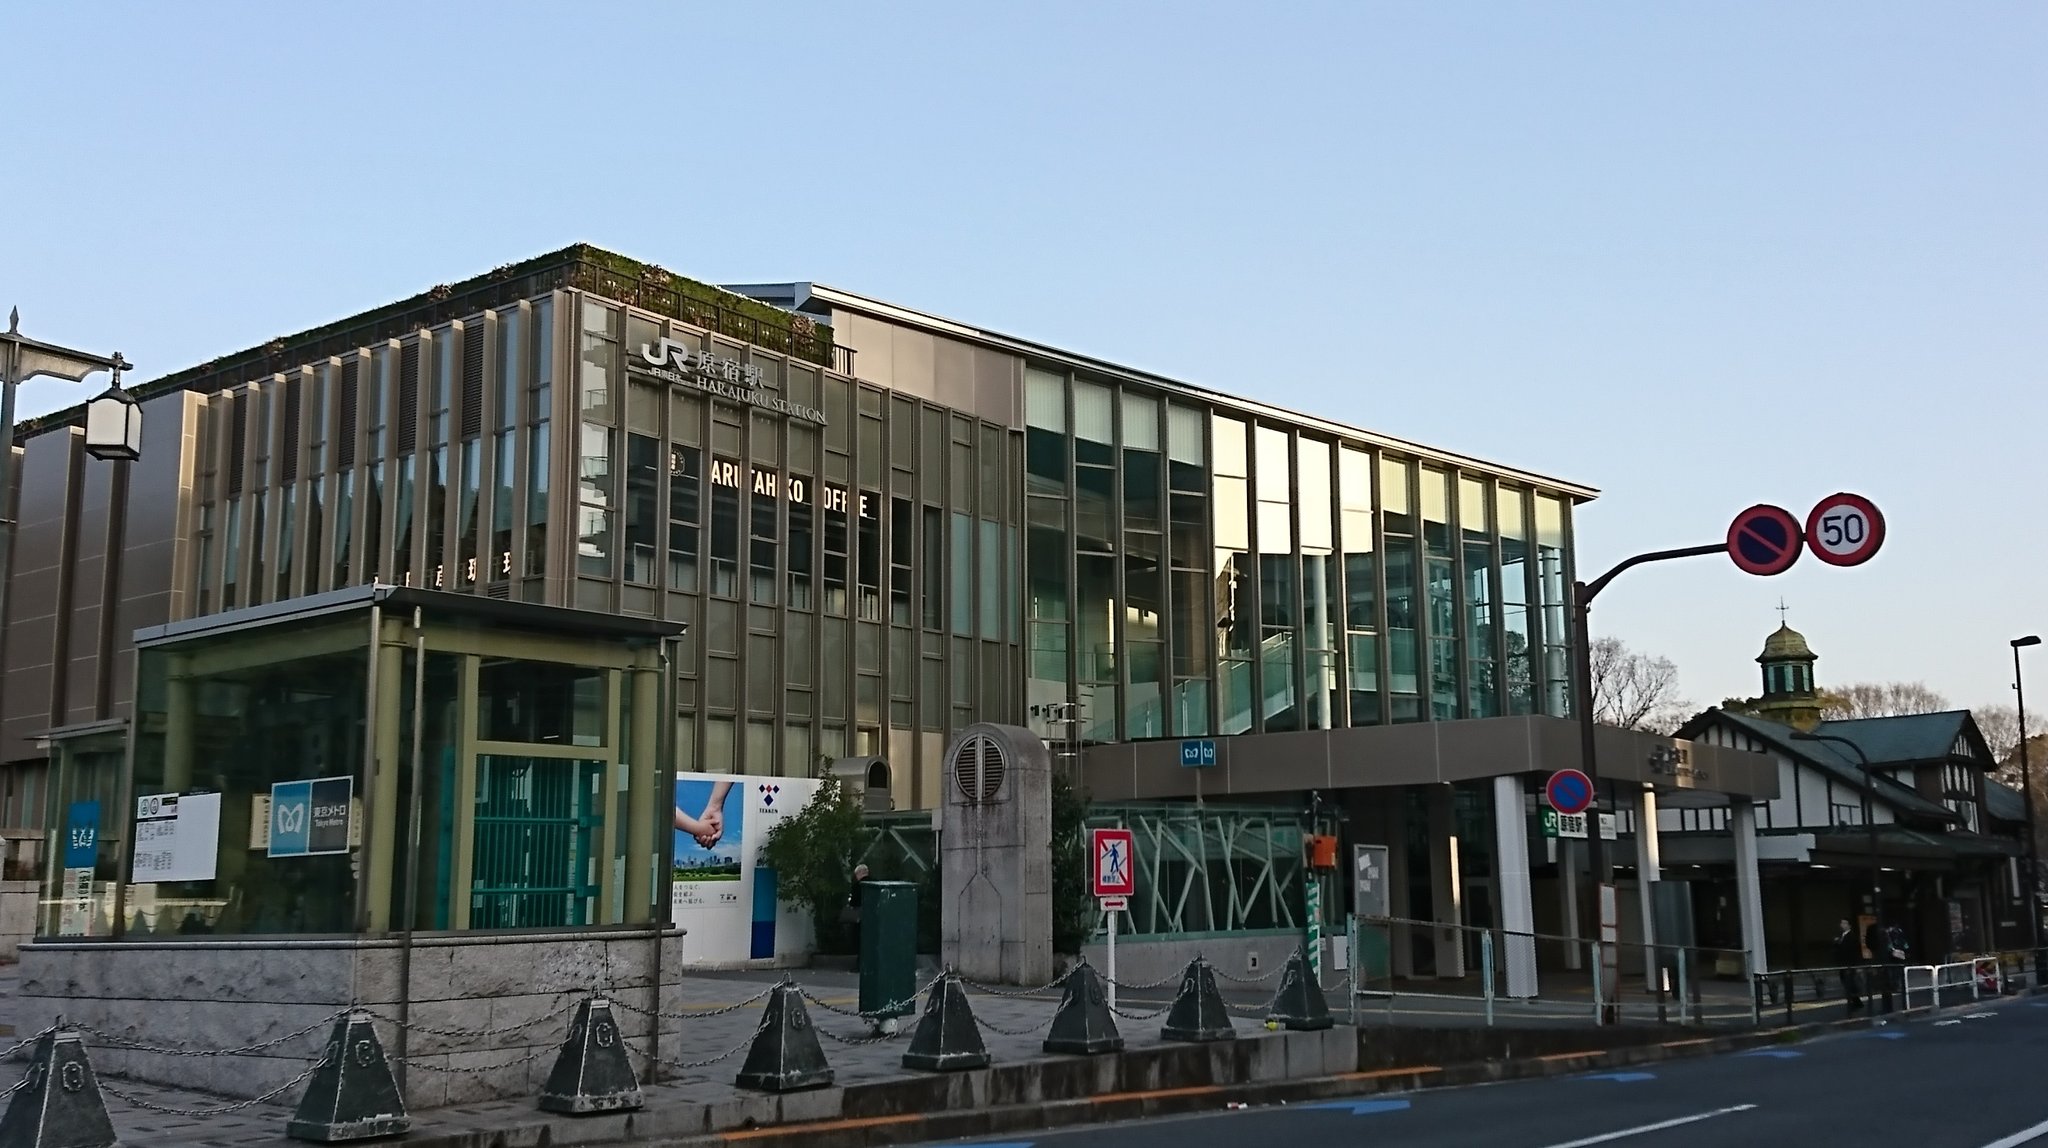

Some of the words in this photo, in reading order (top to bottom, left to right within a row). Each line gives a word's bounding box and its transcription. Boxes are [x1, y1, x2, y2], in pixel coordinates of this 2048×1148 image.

[641, 336, 689, 373] JR
[697, 349, 764, 389] 原宿駅
[697, 376, 769, 408] HARAJUKU
[772, 398, 826, 425] STATION
[1823, 513, 1864, 546] 50
[313, 804, 347, 818] 東京メトロ
[1544, 811, 1558, 828] JR
